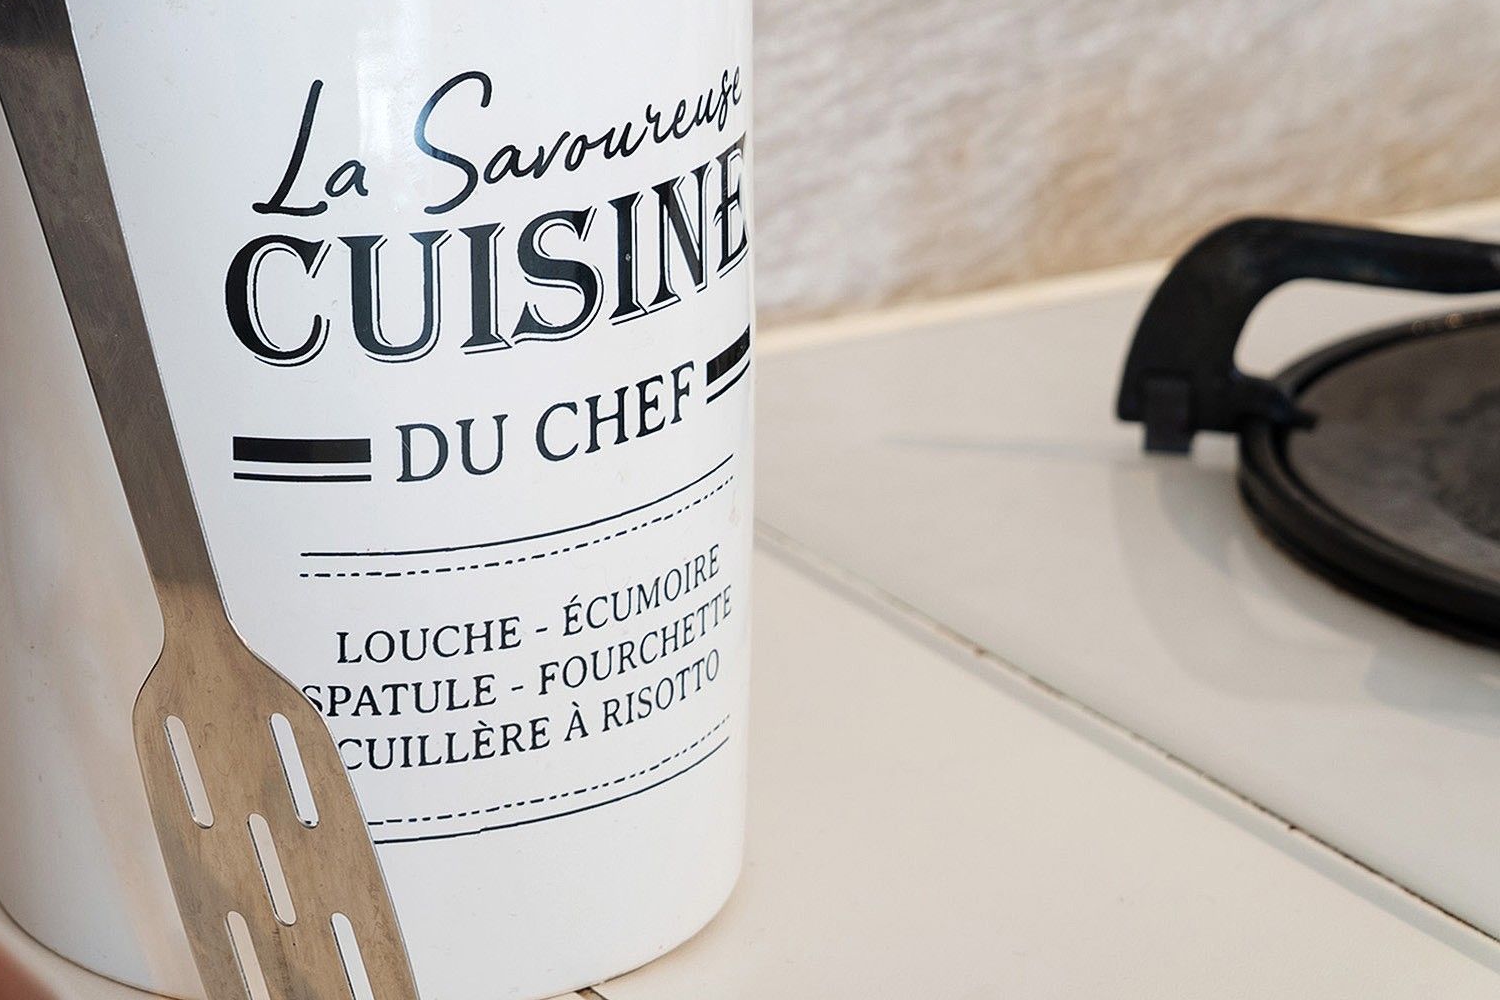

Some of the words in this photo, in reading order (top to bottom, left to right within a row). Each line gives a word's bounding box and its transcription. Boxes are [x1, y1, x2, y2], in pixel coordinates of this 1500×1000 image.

[252, 80, 369, 217] La
[413, 66, 742, 215] Savoureuse
[224, 131, 749, 368] CUISINE
[396, 413, 509, 482] DU
[535, 360, 695, 461] CHEF
[302, 674, 497, 718] SPATULE
[539, 584, 733, 695] FOURCHETTE
[337, 617, 522, 664] LOUCHE
[562, 544, 720, 637] ÉCUMOIRE
[564, 702, 589, 742] À
[601, 649, 720, 732] RISOTTO
